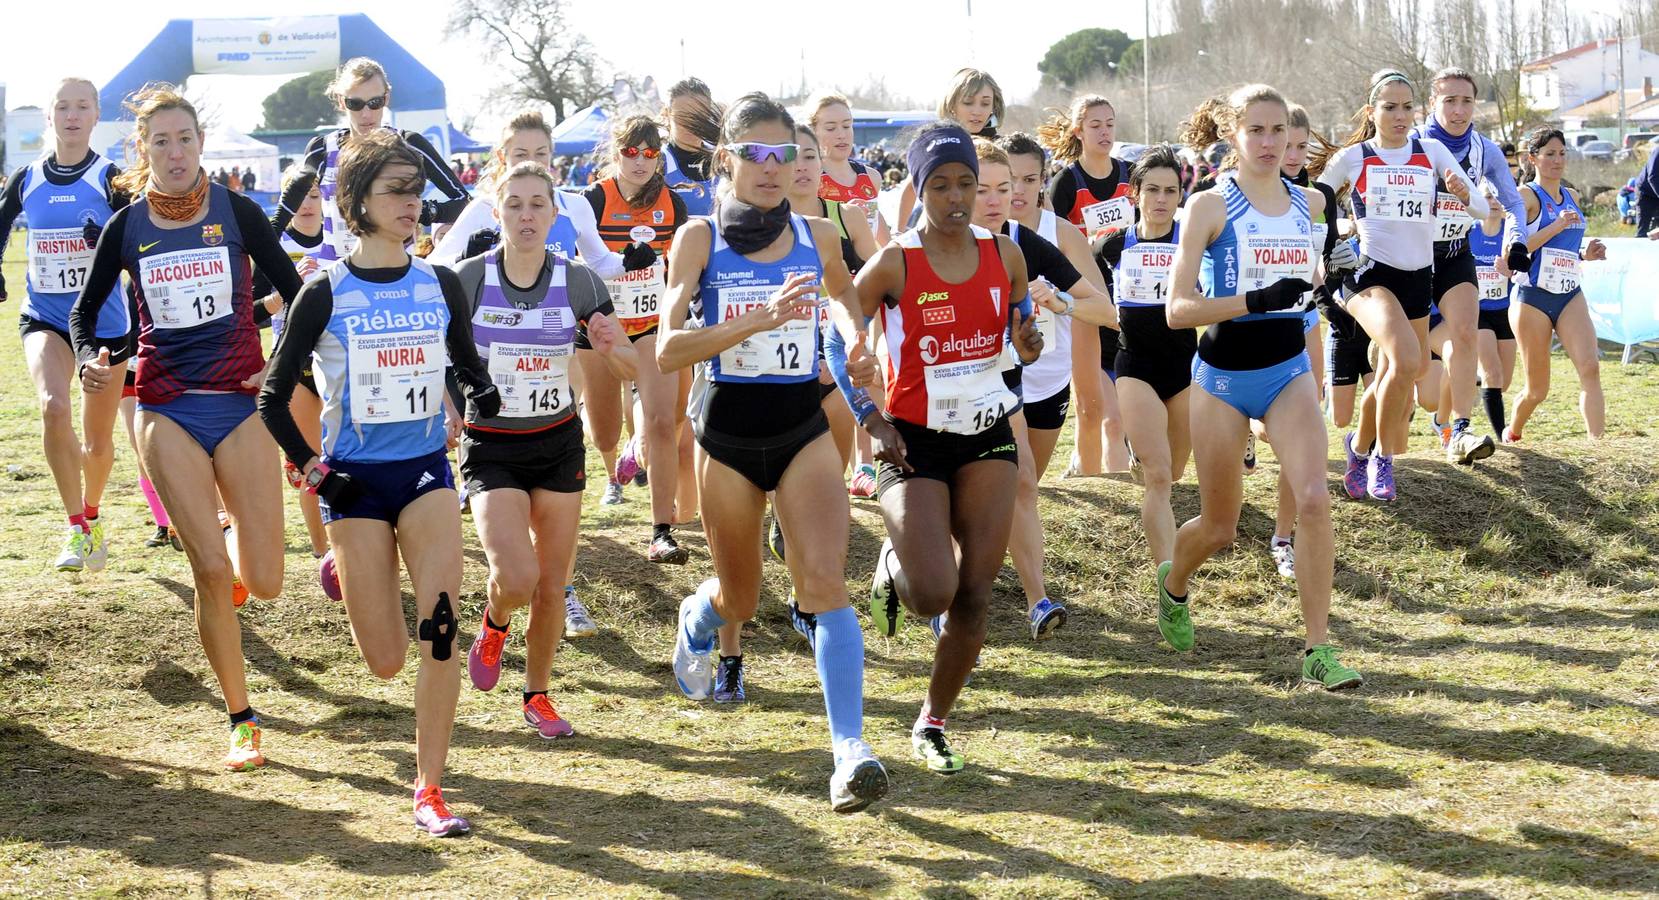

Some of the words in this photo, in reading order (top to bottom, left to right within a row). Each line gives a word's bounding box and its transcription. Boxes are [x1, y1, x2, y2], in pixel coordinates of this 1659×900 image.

[291, 31, 337, 41] Valladolid
[217, 52, 250, 61] FMD
[1387, 174, 1415, 186] LIDIA
[1096, 207, 1123, 225] 3522
[1397, 199, 1422, 218] 134
[1441, 223, 1464, 238] 154
[36, 239, 86, 254] KRISTINA
[1142, 253, 1173, 267] ELISA
[1254, 248, 1308, 265] YOLANDA
[1552, 257, 1575, 269] JUDITH
[58, 267, 87, 289] 137
[147, 260, 224, 284] JACQUELIN
[717, 270, 754, 280] hummel
[1477, 272, 1500, 281] STHER
[1485, 287, 1502, 298] 150
[192, 295, 215, 320] 13
[632, 293, 657, 314] 156
[942, 328, 999, 357] alquiber
[377, 347, 425, 368] NURIA
[516, 357, 550, 371] ALMA
[776, 342, 799, 369] 12
[406, 386, 427, 414] 11
[528, 388, 560, 412] 143
